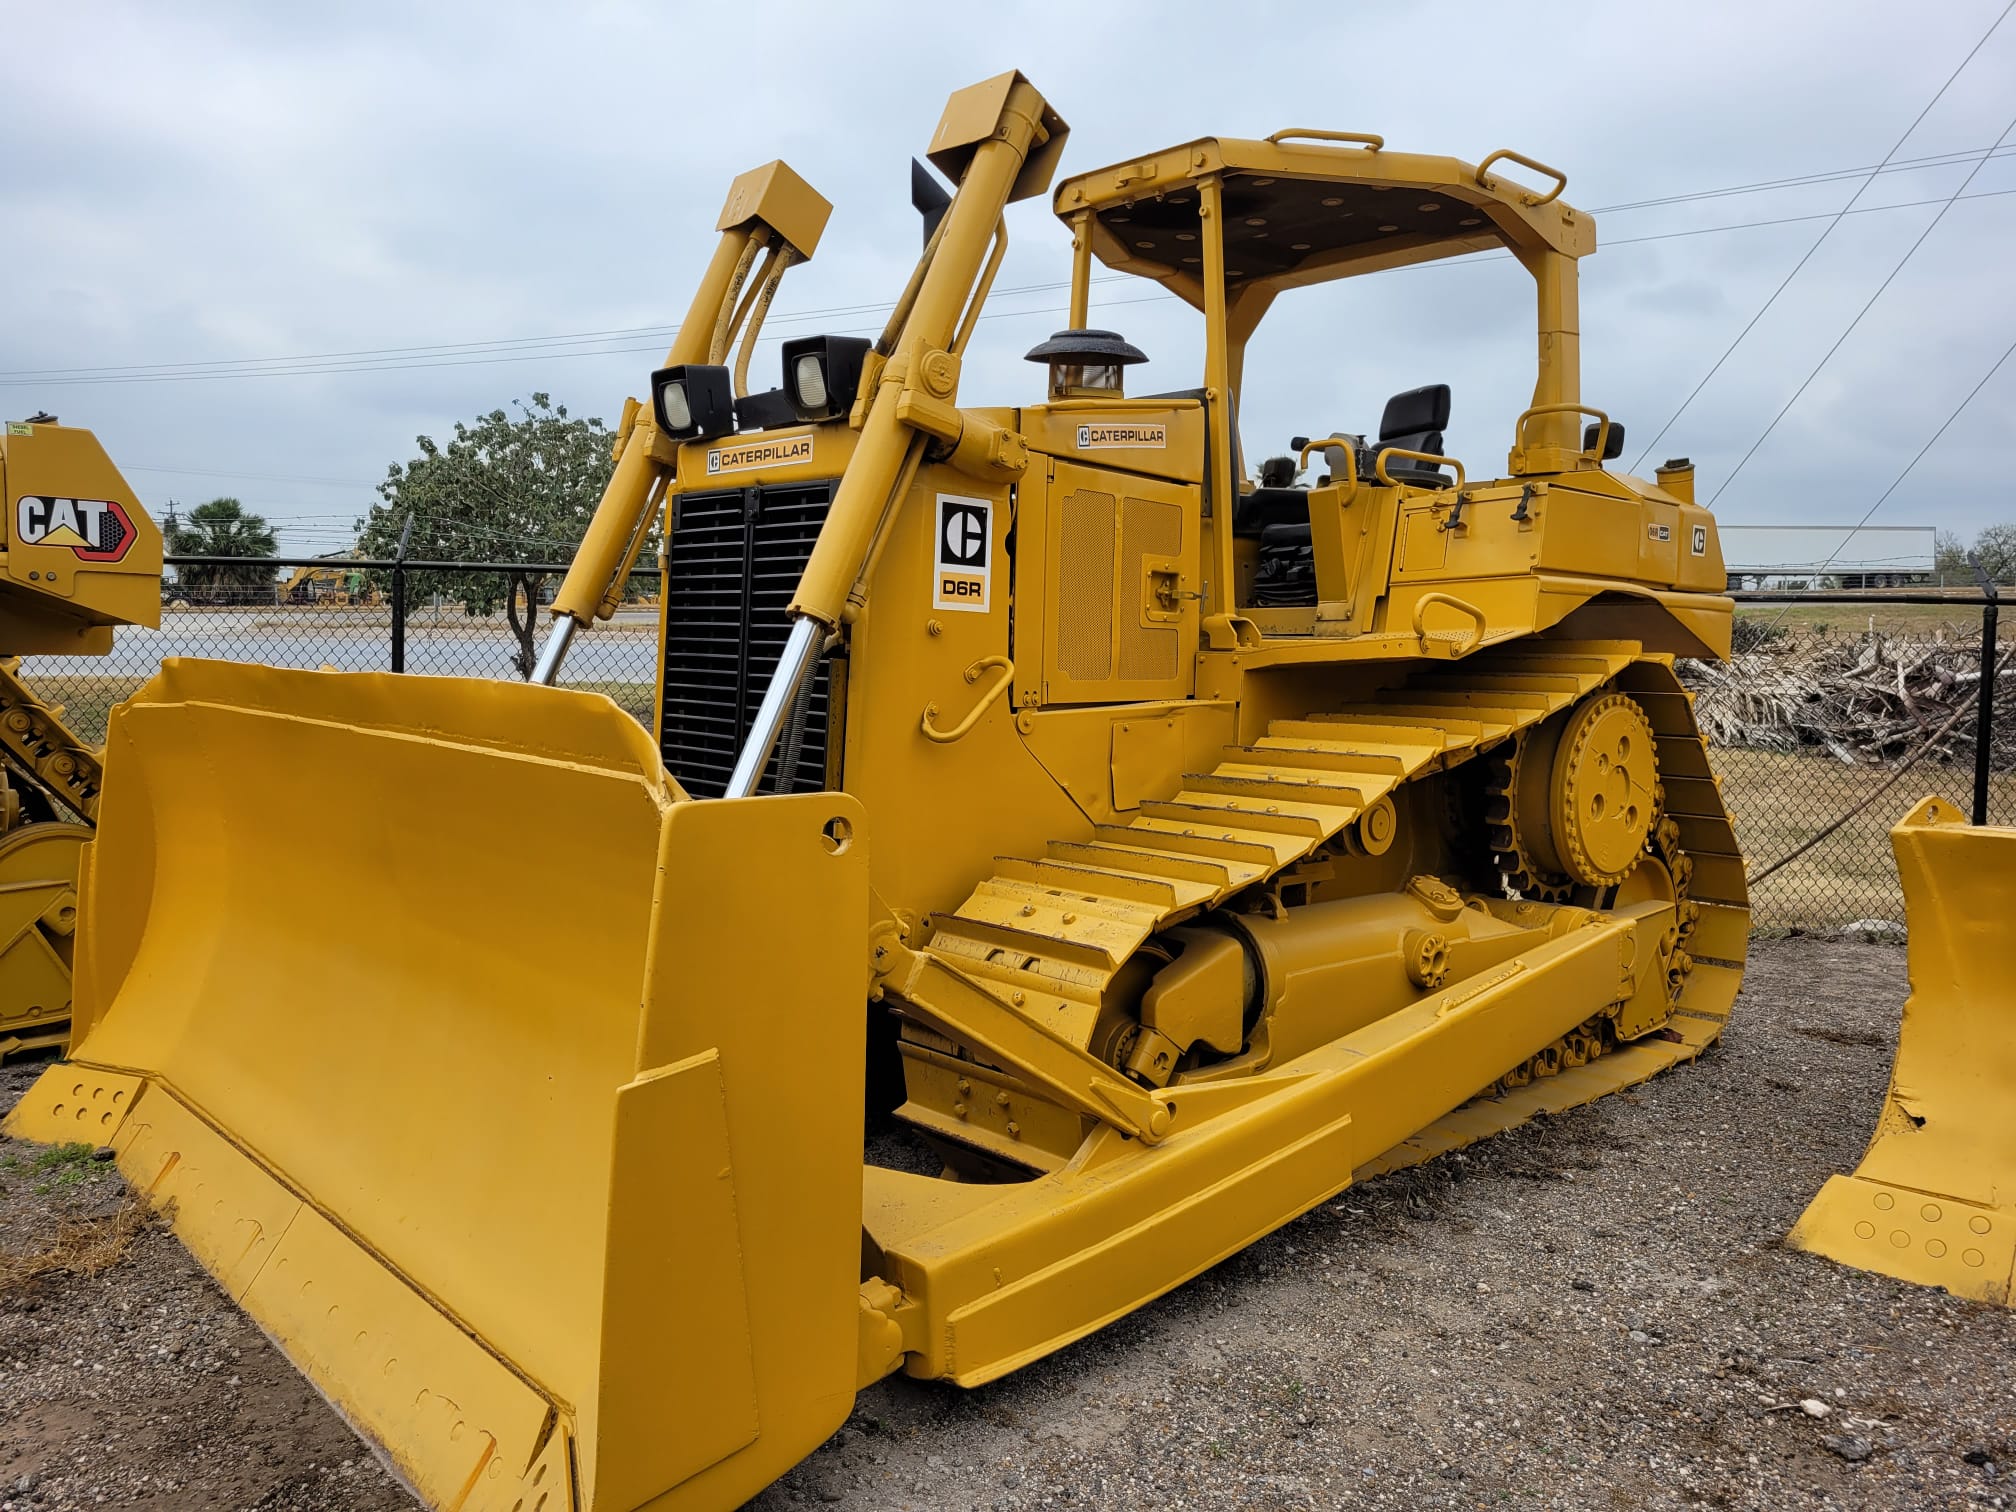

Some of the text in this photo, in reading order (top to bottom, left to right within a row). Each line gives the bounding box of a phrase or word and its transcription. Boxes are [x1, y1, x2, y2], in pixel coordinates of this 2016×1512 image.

[1091, 430, 1164, 442] CATERPILLAR
[721, 442, 810, 466] CATERPILLAR
[18, 496, 108, 548] CAT
[943, 580, 981, 597] D6R
